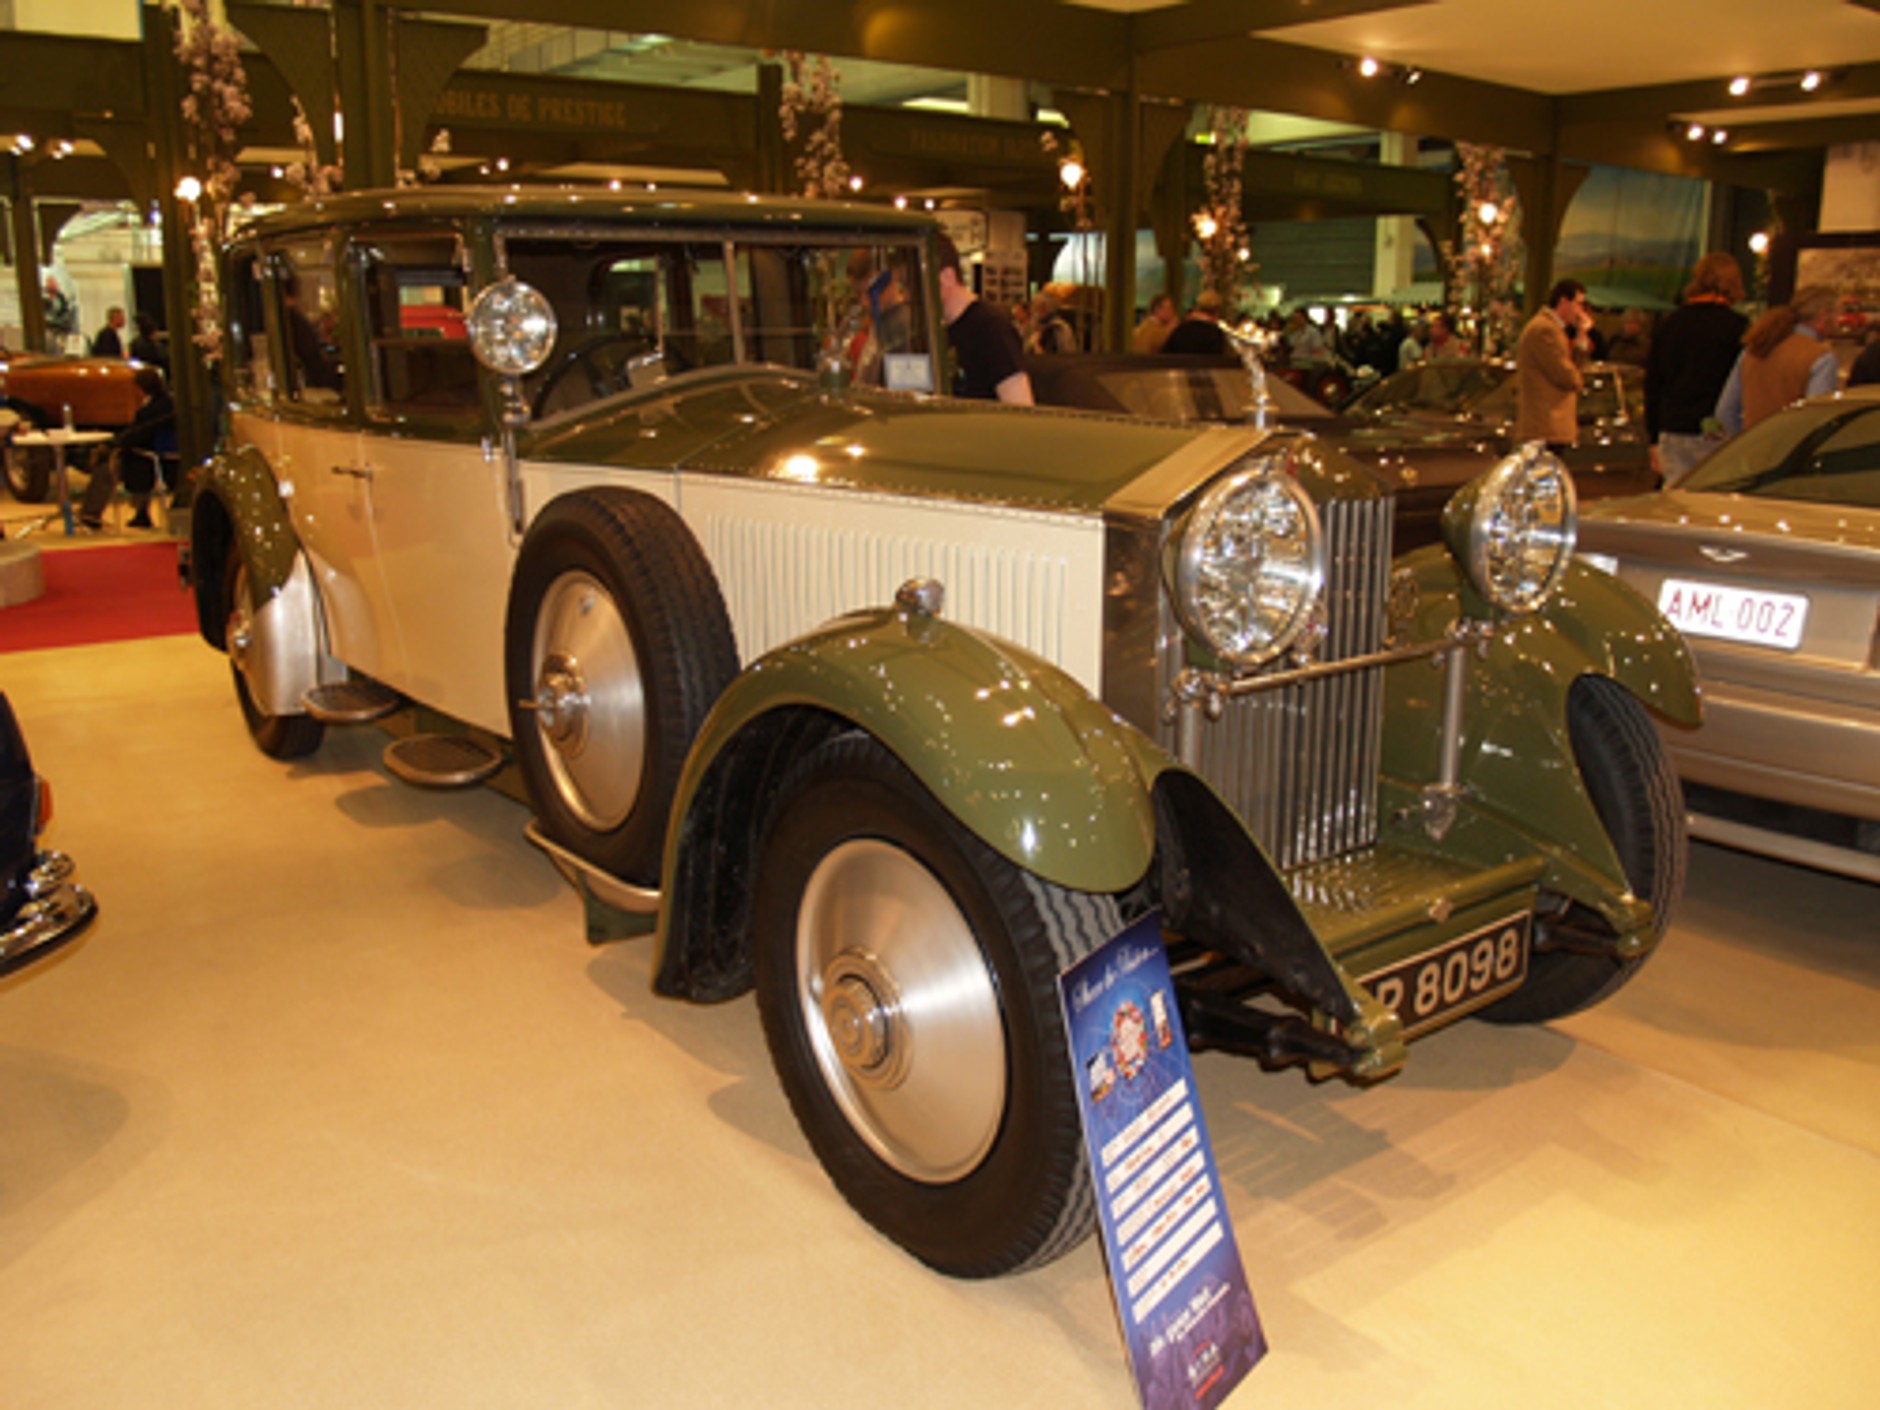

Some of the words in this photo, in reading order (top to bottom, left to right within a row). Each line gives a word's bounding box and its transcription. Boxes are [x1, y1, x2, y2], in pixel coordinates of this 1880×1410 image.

[507, 92, 531, 122] DE
[537, 96, 627, 127] PRESTIGE
[1667, 588, 1724, 629] AML
[1737, 597, 1795, 637] 002
[1414, 928, 1519, 1015] 8098
